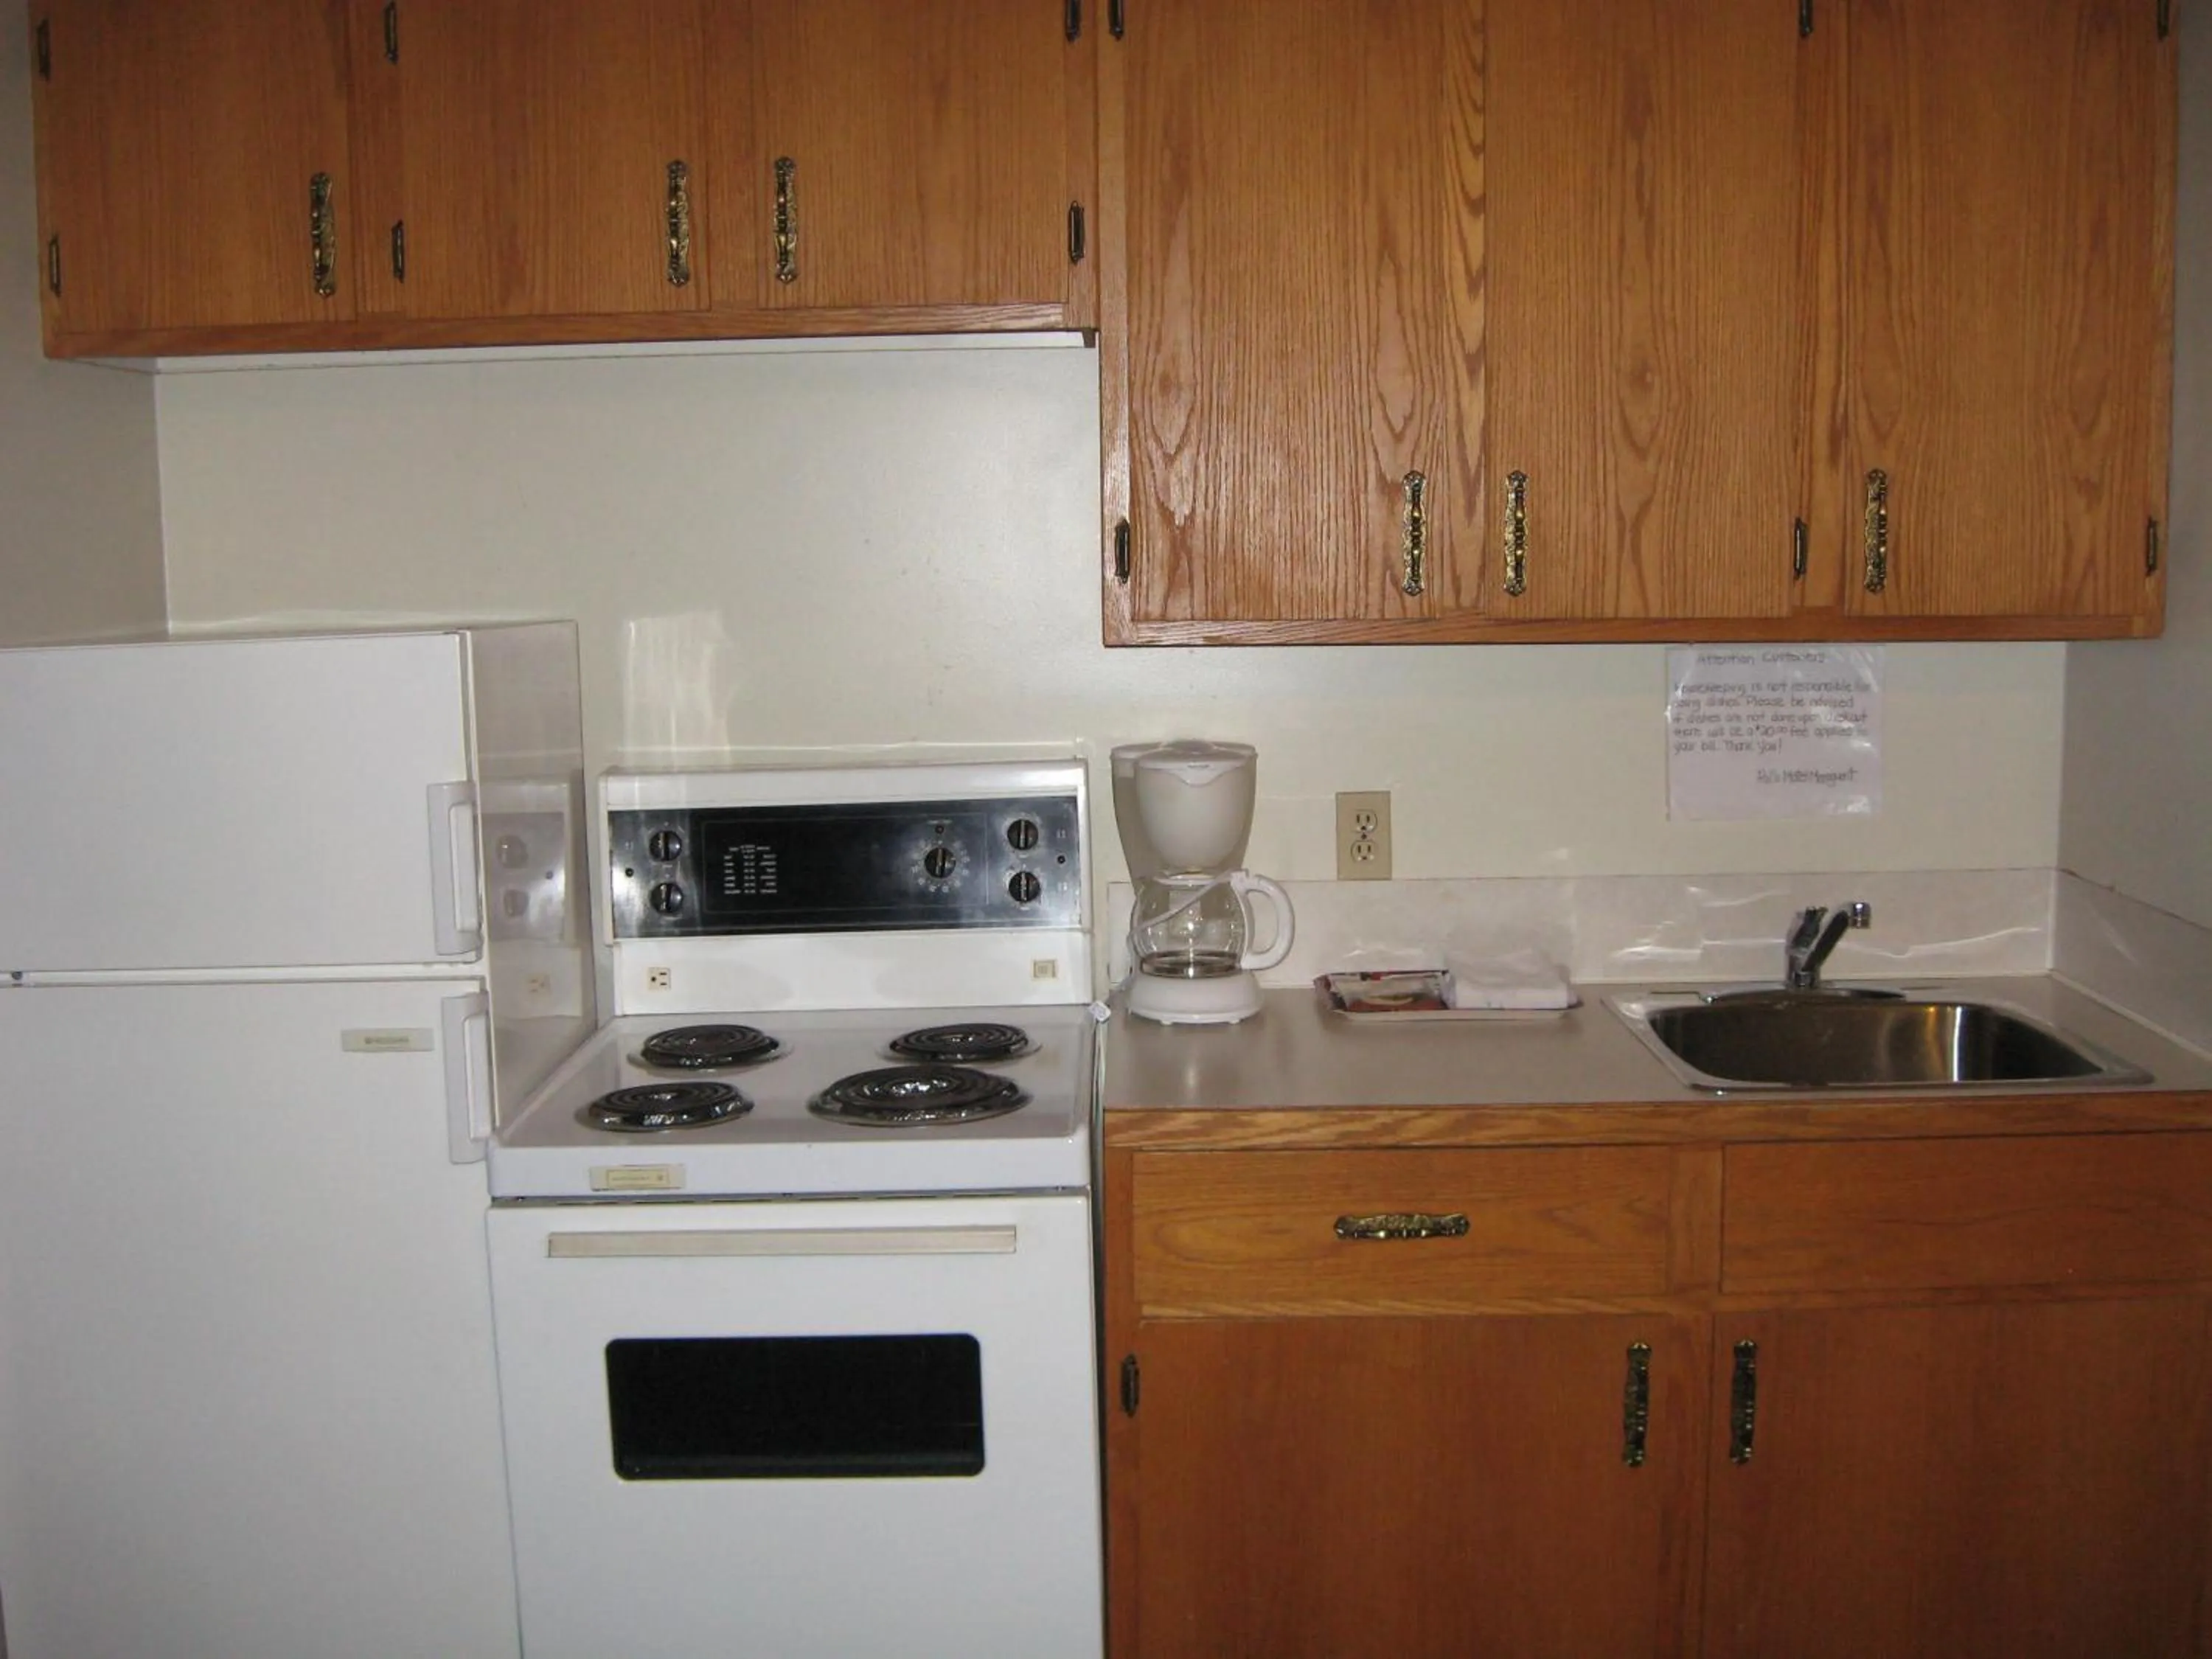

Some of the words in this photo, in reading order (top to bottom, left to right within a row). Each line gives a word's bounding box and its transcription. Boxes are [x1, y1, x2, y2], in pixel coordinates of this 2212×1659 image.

[1767, 682, 1787, 692] not
[1791, 694, 1805, 707] be
[1746, 711, 1765, 722] not
